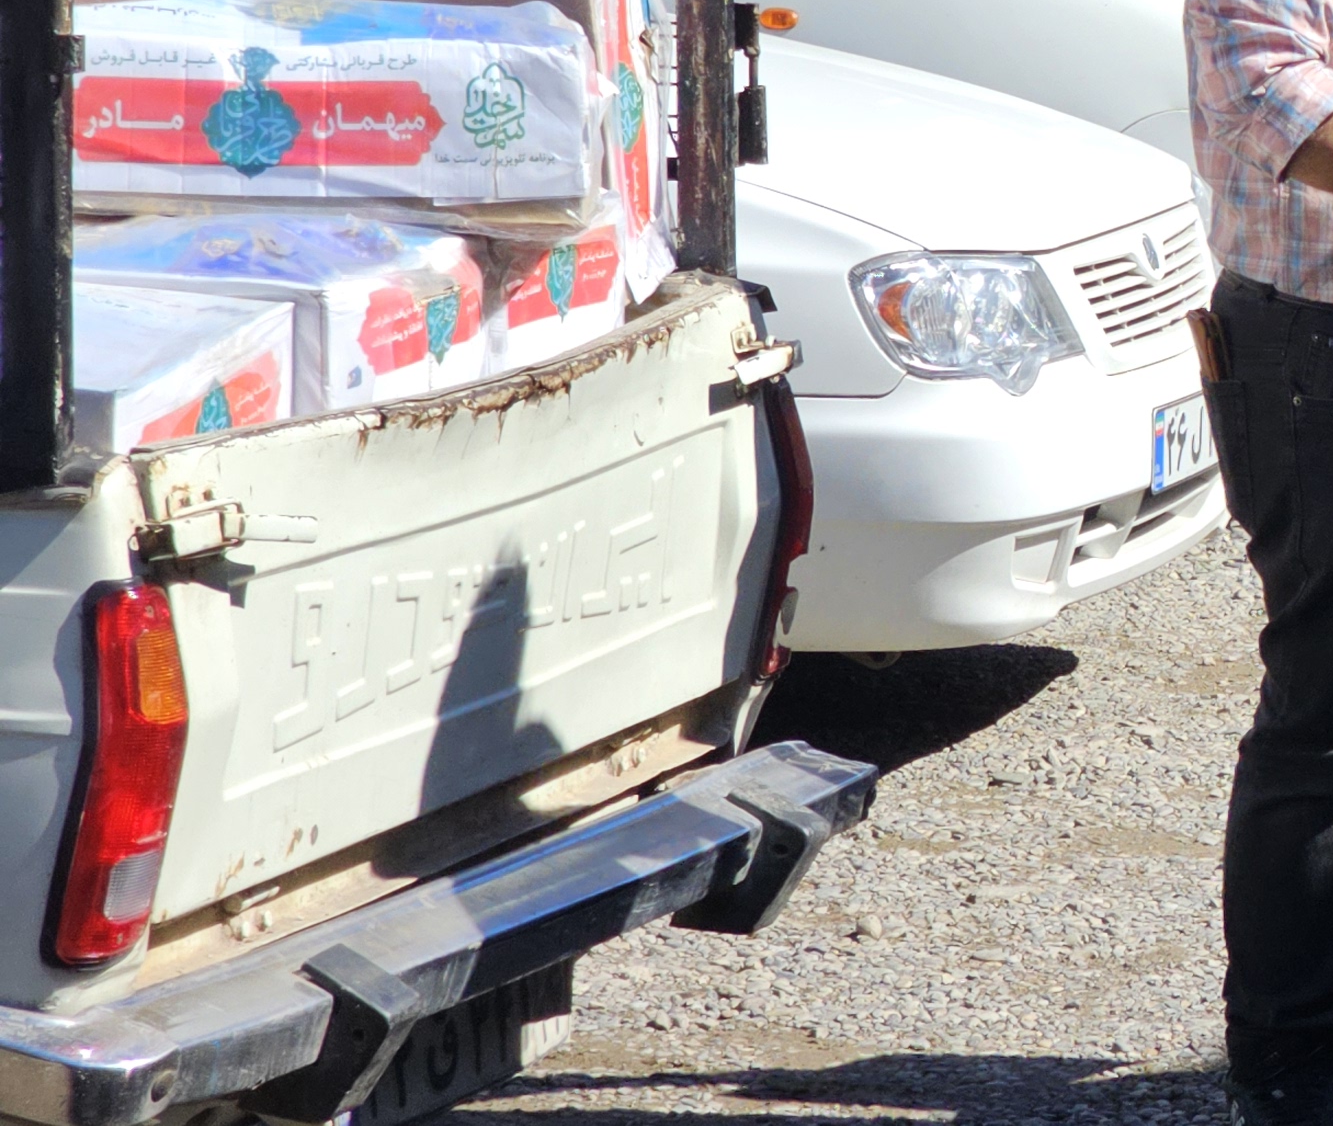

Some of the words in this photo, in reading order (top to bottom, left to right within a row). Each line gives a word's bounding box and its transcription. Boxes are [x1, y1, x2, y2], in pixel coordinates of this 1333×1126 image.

[91, 49, 136, 65] فروش
[138, 50, 179, 63] قابل
[183, 53, 216, 67] غیر
[286, 55, 338, 71] مشارکتی
[341, 54, 385, 70] قربانی
[389, 54, 417, 70] طرح
[83, 99, 184, 138] مادر
[311, 102, 426, 140] میهمان
[434, 153, 451, 163] خدا
[529, 153, 556, 165] برنامه
